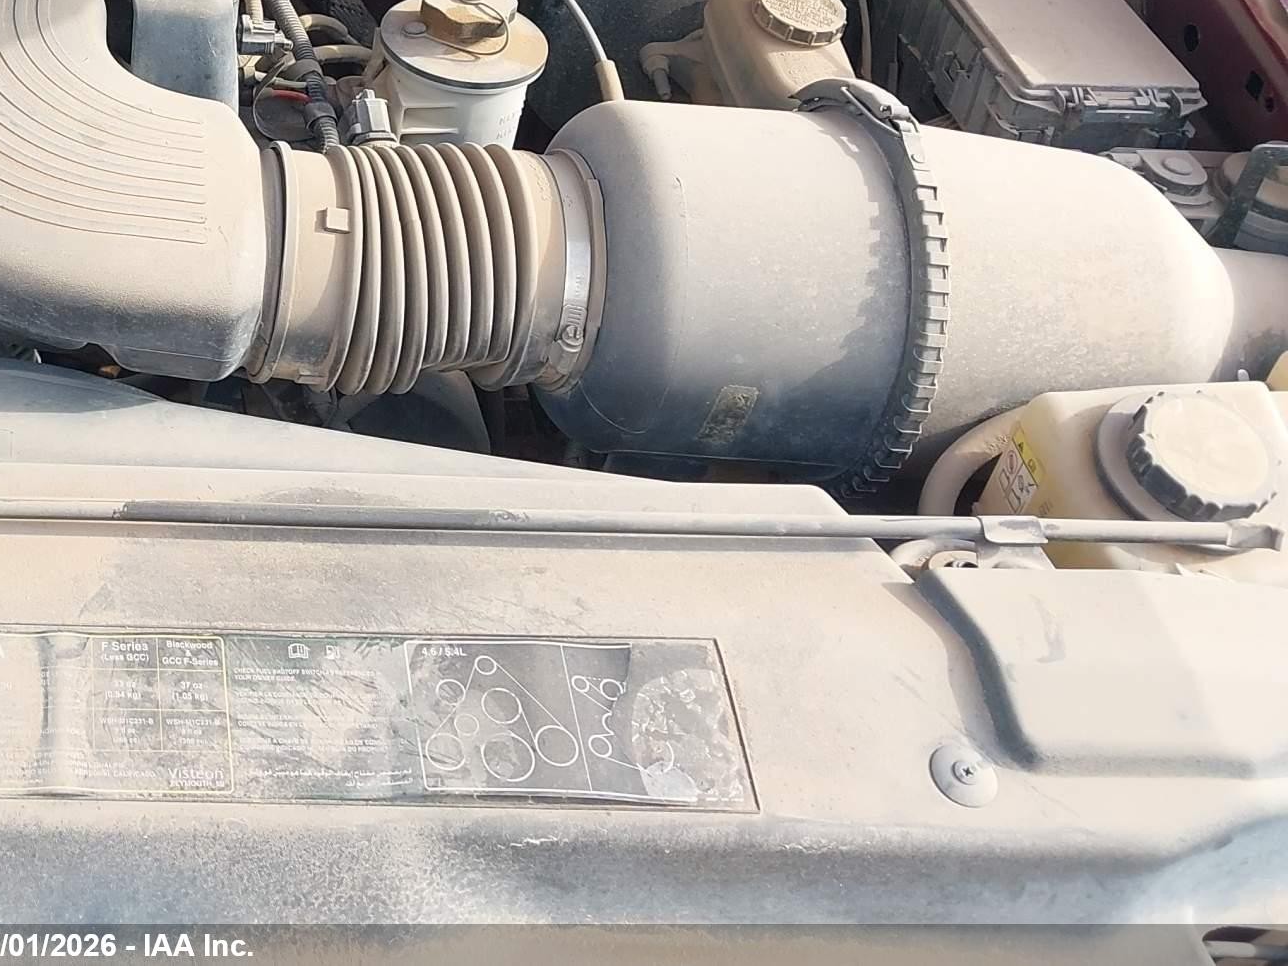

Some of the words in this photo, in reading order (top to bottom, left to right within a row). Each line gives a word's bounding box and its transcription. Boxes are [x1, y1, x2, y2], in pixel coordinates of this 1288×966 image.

[101, 641, 109, 652] F
[111, 640, 148, 652] Series
[165, 640, 213, 650] Blackwood
[100, 653, 124, 662] (Less
[126, 653, 150, 663] GCC)
[161, 657, 183, 666] GCC
[183, 657, 219, 667] F-Series
[167, 767, 224, 780] Visteon
